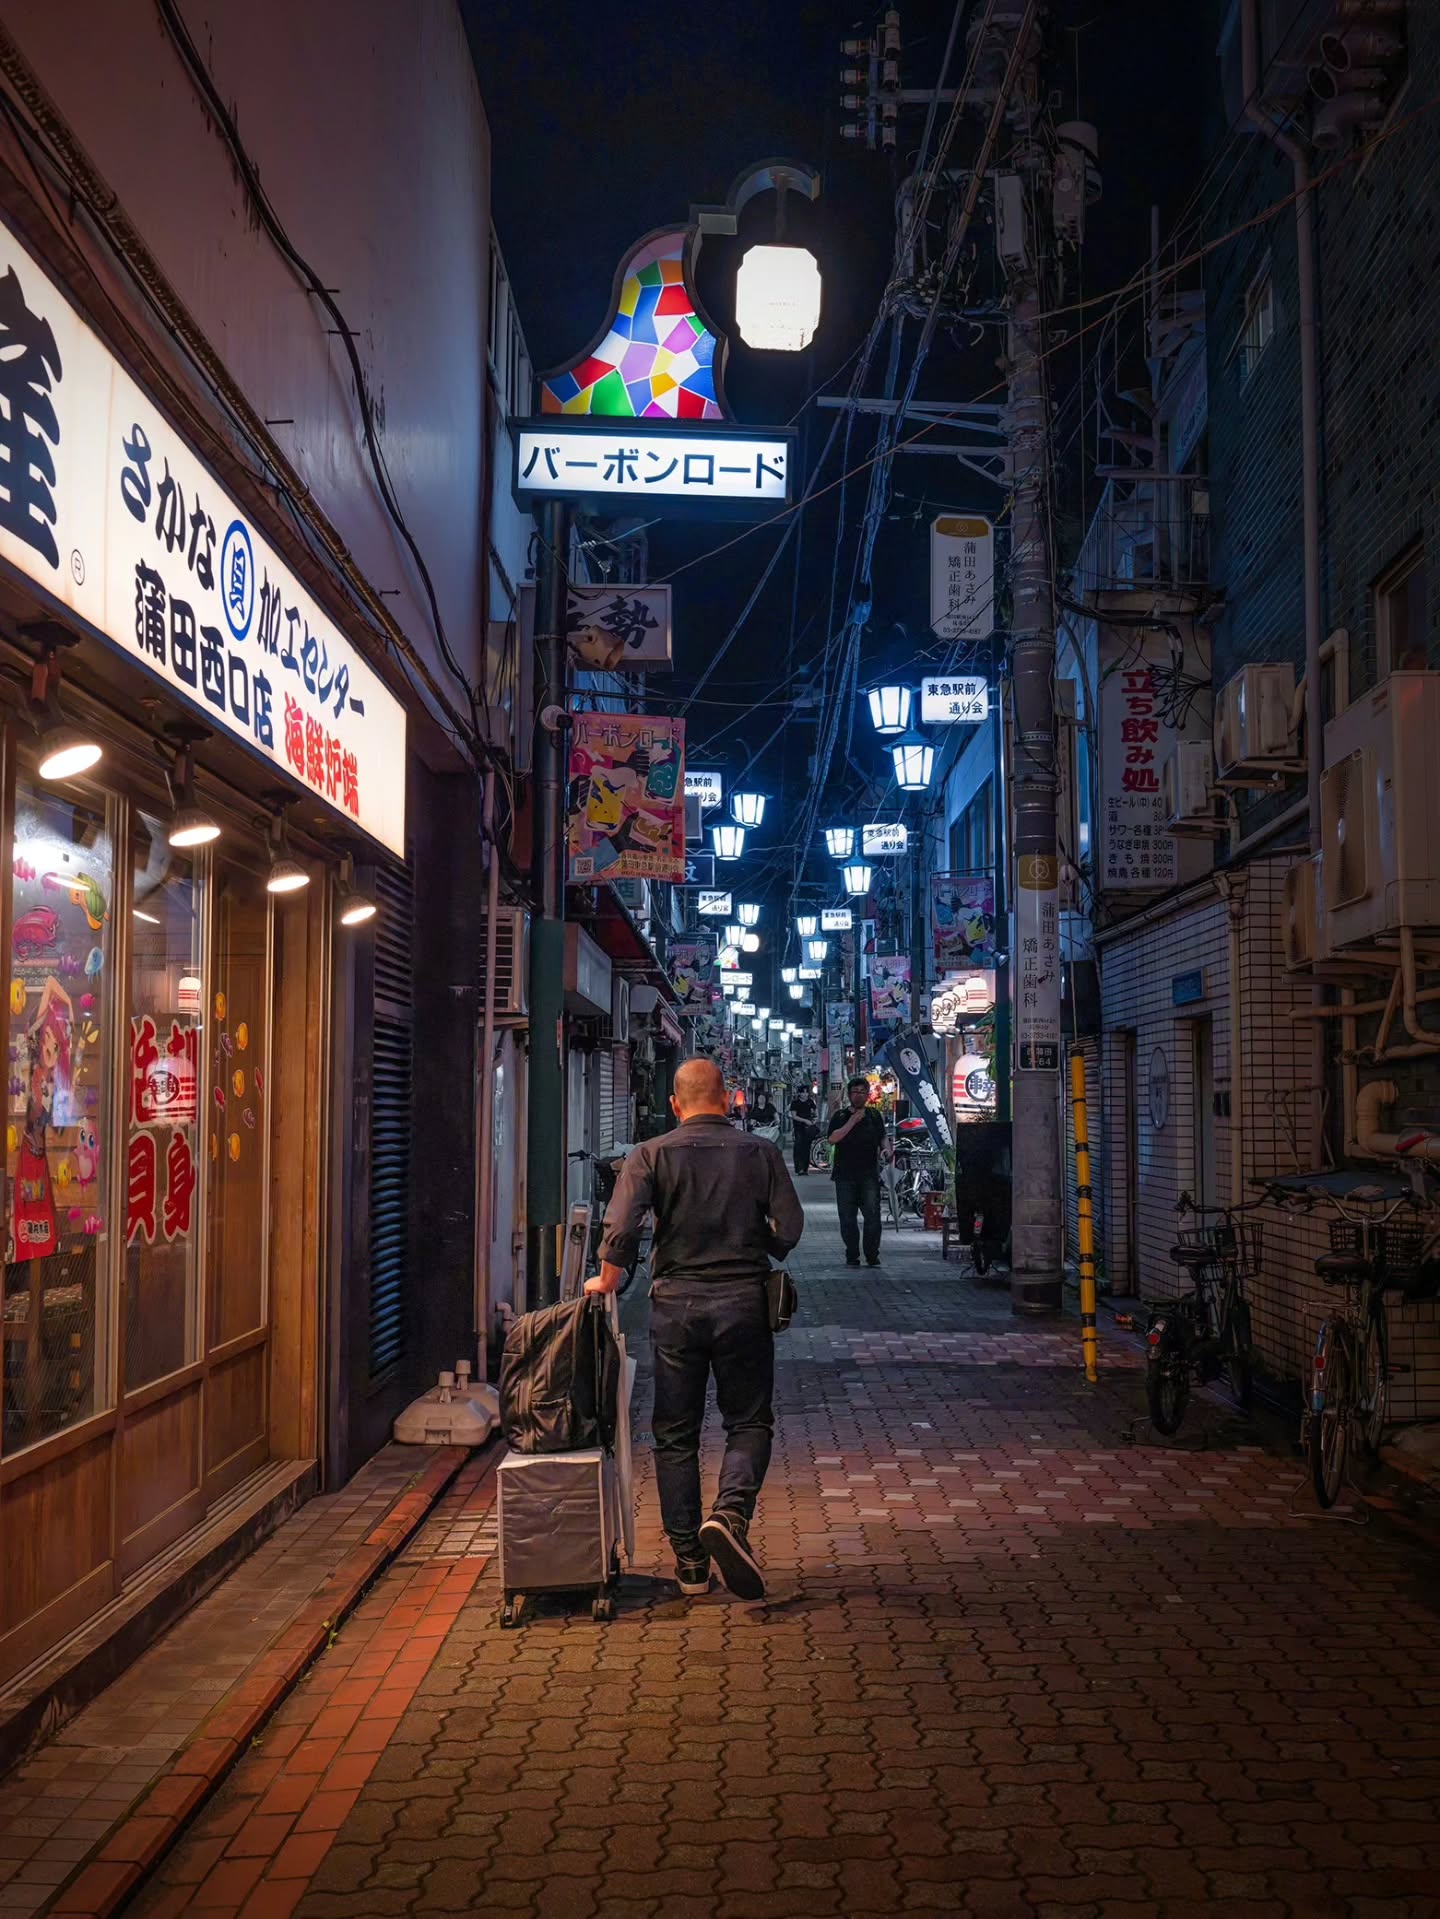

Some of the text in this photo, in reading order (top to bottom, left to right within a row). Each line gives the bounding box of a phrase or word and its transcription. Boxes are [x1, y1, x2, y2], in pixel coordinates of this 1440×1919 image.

[522, 446, 785, 489] バーボンロード
[947, 555, 961, 612] 矯正歯科
[964, 541, 976, 606] 蒲田あさみ
[135, 558, 359, 818] 蒲田西口店 海鮮炉端
[927, 683, 976, 697] 東急駅前
[948, 701, 983, 715] 通り会
[574, 720, 681, 750] バーボンロード
[1121, 669, 1159, 793] 立ち飲み処
[881, 840, 904, 850] 通り会
[1041, 901, 1056, 984] 蒲田あさみ
[1022, 937, 1039, 1009] 矯正歯科
